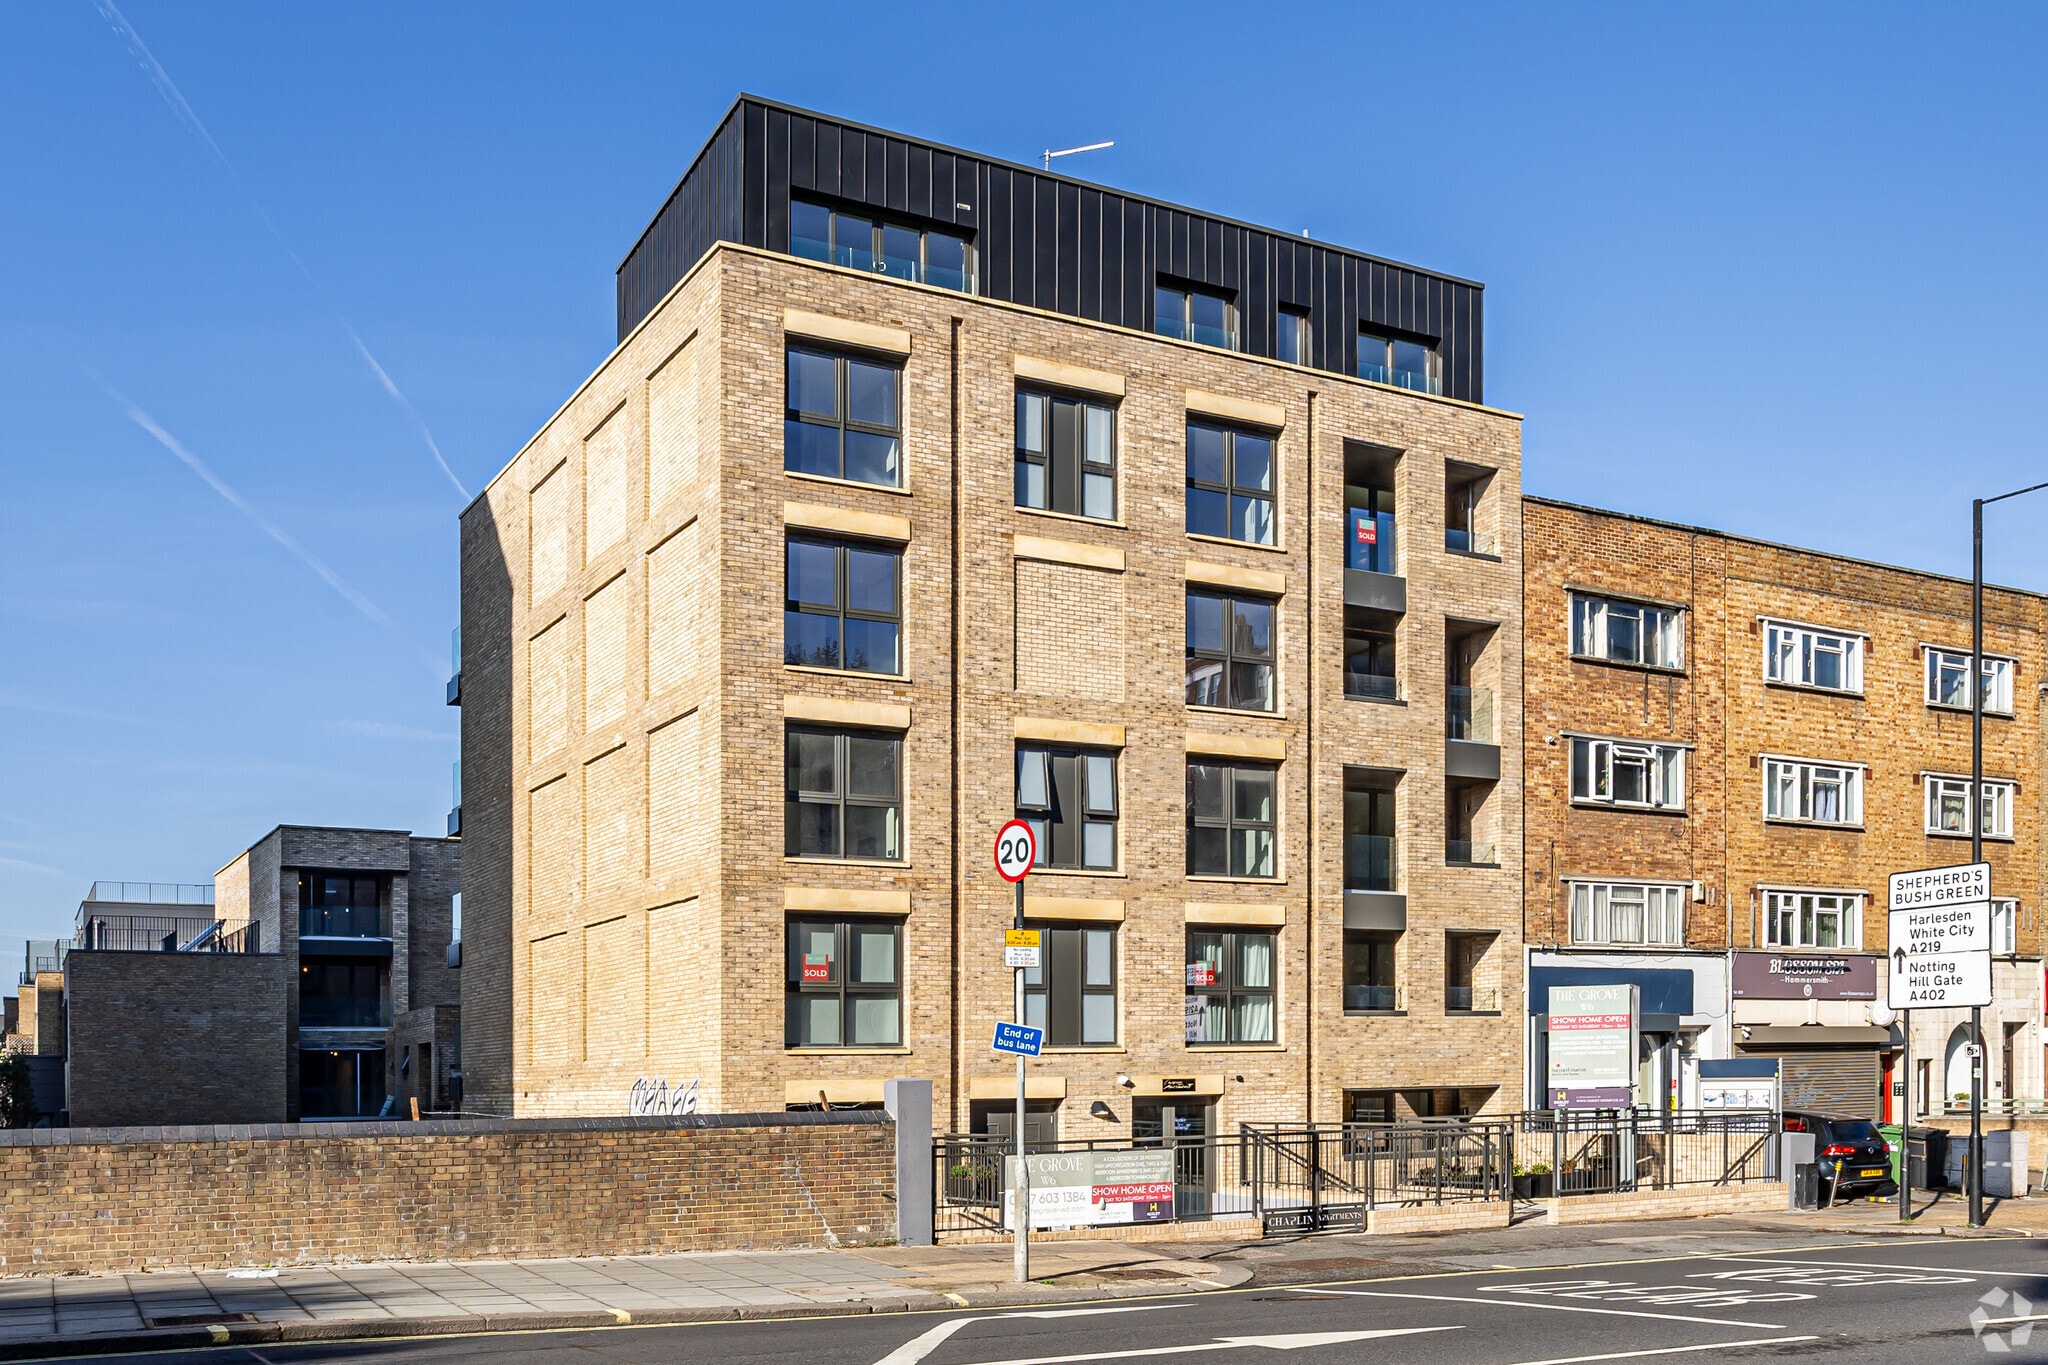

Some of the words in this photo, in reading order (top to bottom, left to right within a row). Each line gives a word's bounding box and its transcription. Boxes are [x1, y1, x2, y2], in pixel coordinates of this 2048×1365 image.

[1359, 532, 1375, 540] SOLD
[1001, 838, 1028, 864] 20
[1897, 870, 1983, 890] SHEPHERD'S
[1895, 891, 1932, 904] BUSH
[1936, 885, 1983, 900] GREEN
[1910, 911, 1971, 925] Harlesden
[1910, 927, 1945, 939] White
[1949, 925, 1974, 936] City
[1910, 941, 1941, 954] A219
[1769, 959, 1823, 975] BLOSSOM
[1910, 962, 1955, 973] Notting
[1909, 976, 1929, 987] Hill
[1934, 975, 1963, 986] Gate
[1555, 990, 1575, 1001] THE
[1579, 989, 1620, 1001] GROVE
[1910, 989, 1945, 1001] A402
[1004, 1027, 1021, 1038] End
[1023, 1032, 1034, 1040] of
[997, 1037, 1014, 1047] bus
[1017, 1040, 1036, 1051] lane
[1040, 1156, 1083, 1172] GROVE
[1041, 1176, 1056, 1185] W6
[1092, 1186, 1118, 1196] SHOW
[1121, 1186, 1147, 1194] HOME
[1149, 1184, 1172, 1193] OPEN
[1039, 1193, 1059, 1204] 603
[1063, 1192, 1086, 1202] 1384
[1269, 1216, 1313, 1227] CHAPLIN
[1319, 1212, 1362, 1221] APARTMENTS
[1684, 1266, 1978, 1287] KEEP
[1476, 1280, 1818, 1308] CLEAR
